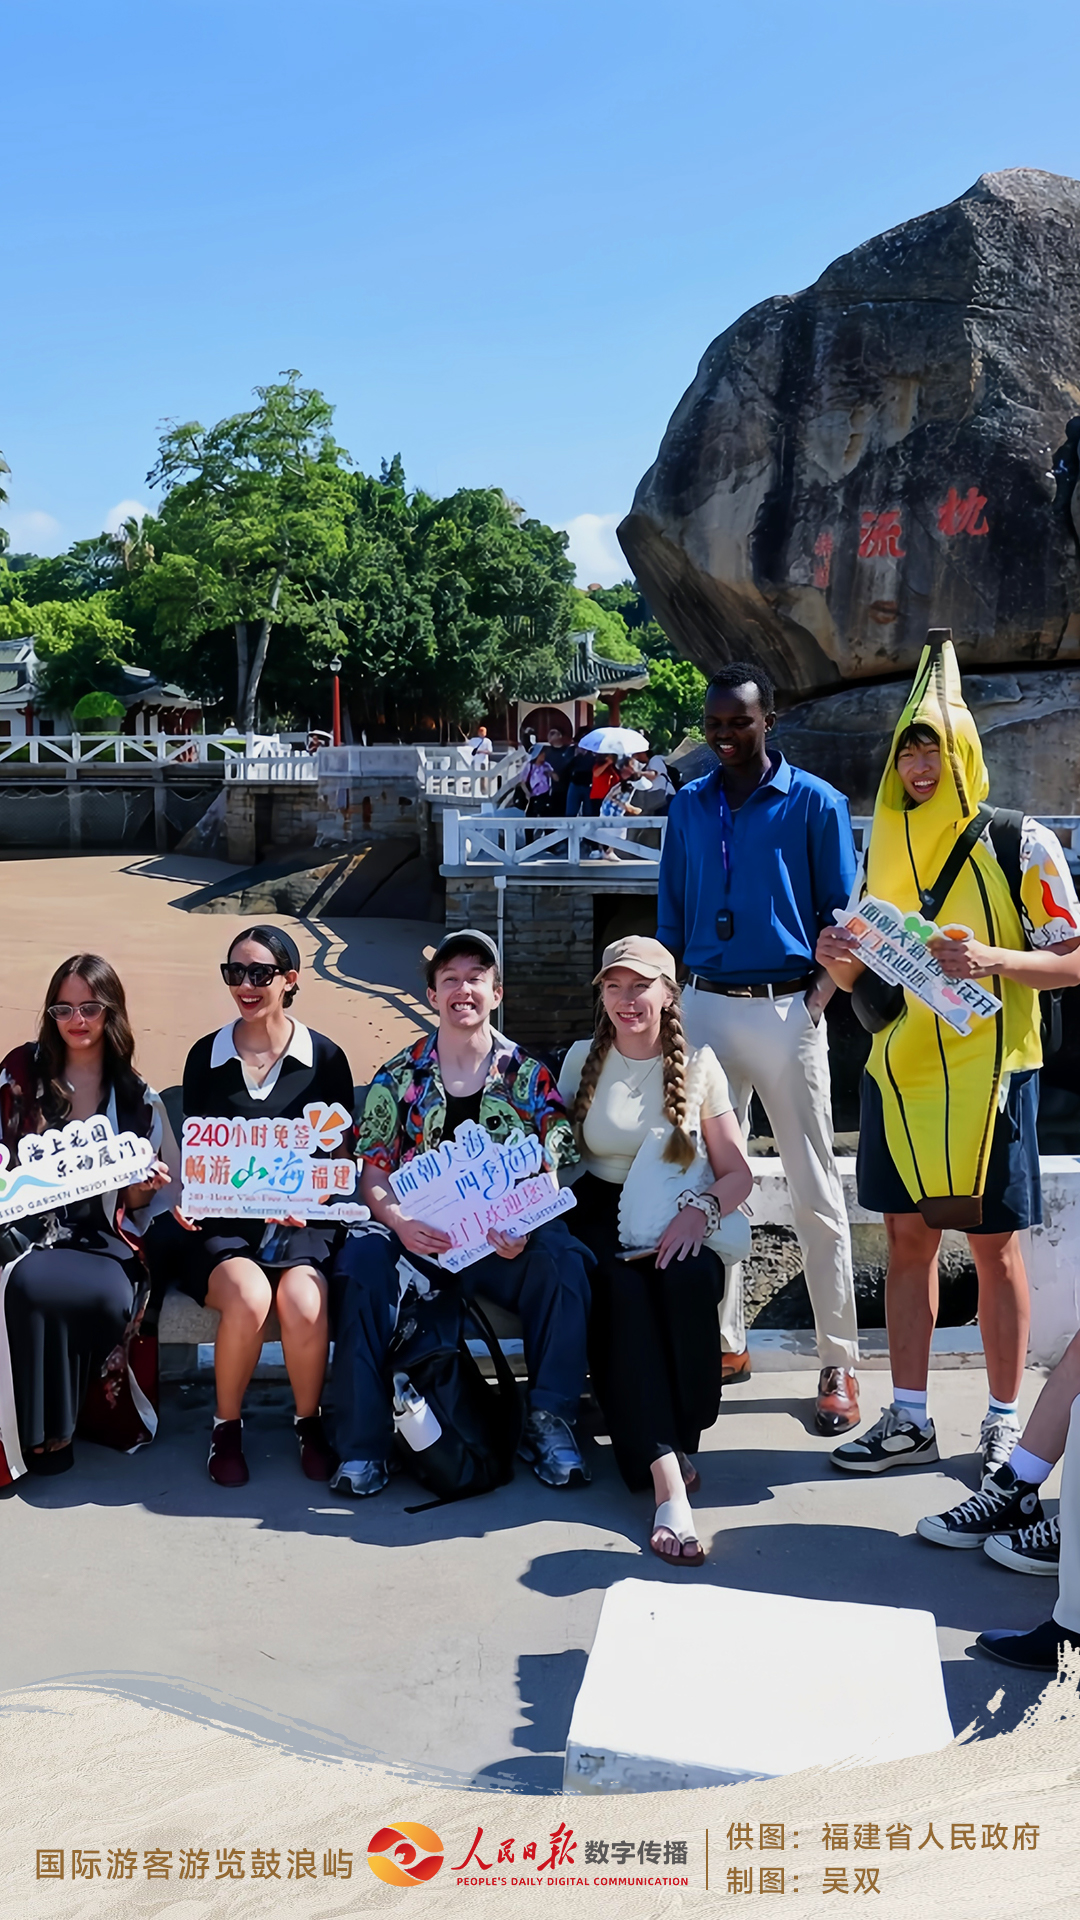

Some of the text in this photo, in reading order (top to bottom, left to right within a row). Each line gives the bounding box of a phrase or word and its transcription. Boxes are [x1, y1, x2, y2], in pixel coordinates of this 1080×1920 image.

[27, 1123, 108, 1162] 海上花园
[186, 1123, 311, 1149] 240小时免签
[185, 1150, 350, 1195] 畅游山海福建
[446, 1241, 491, 1267] Welcom
